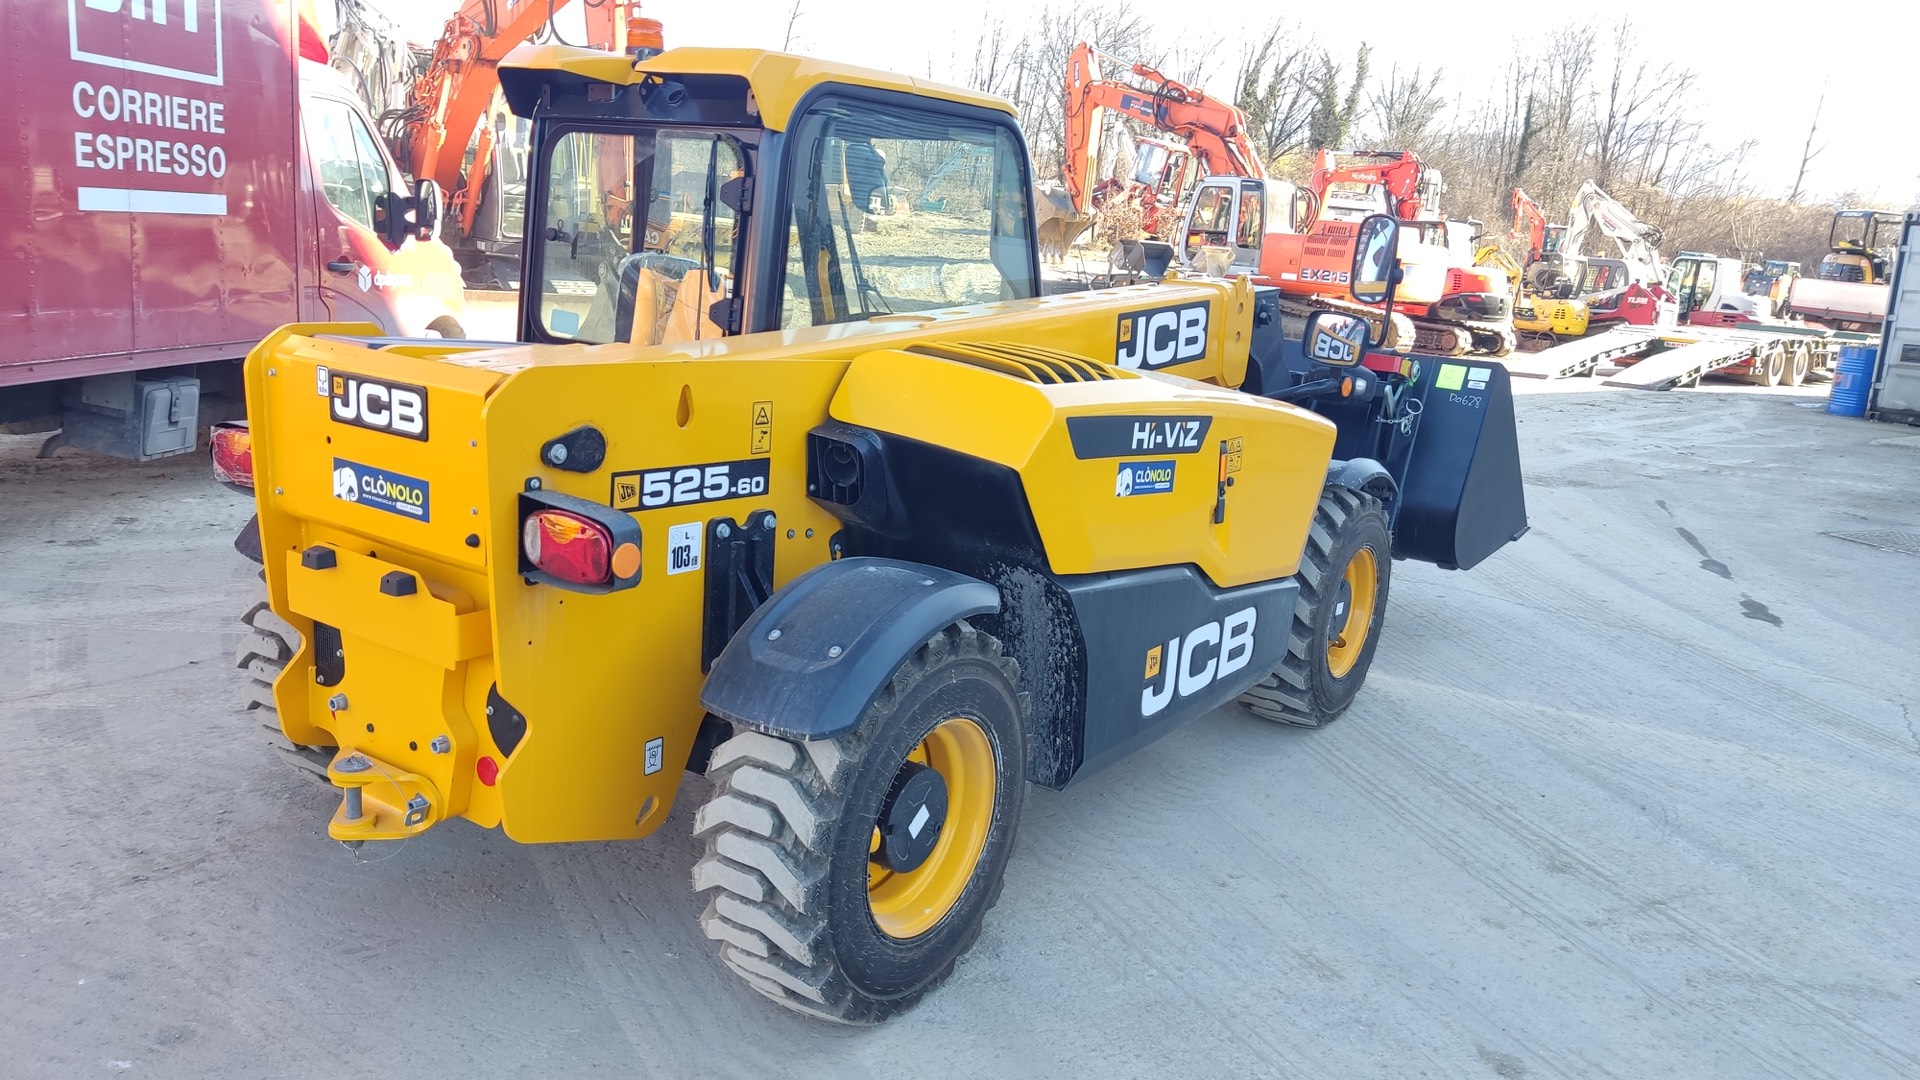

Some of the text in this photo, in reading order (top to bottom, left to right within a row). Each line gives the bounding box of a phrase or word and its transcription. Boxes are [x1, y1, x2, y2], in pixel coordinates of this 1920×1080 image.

[73, 81, 225, 134] CORRIERE
[74, 131, 227, 179] ESPRESSO
[1301, 268, 1349, 283] EX215
[1118, 306, 1207, 370] JCB
[333, 379, 423, 434] JCB
[362, 475, 423, 505] CLÒNOLO
[620, 484, 635, 500] JCB
[671, 544, 691, 570] 103
[1141, 606, 1257, 717] JCB
